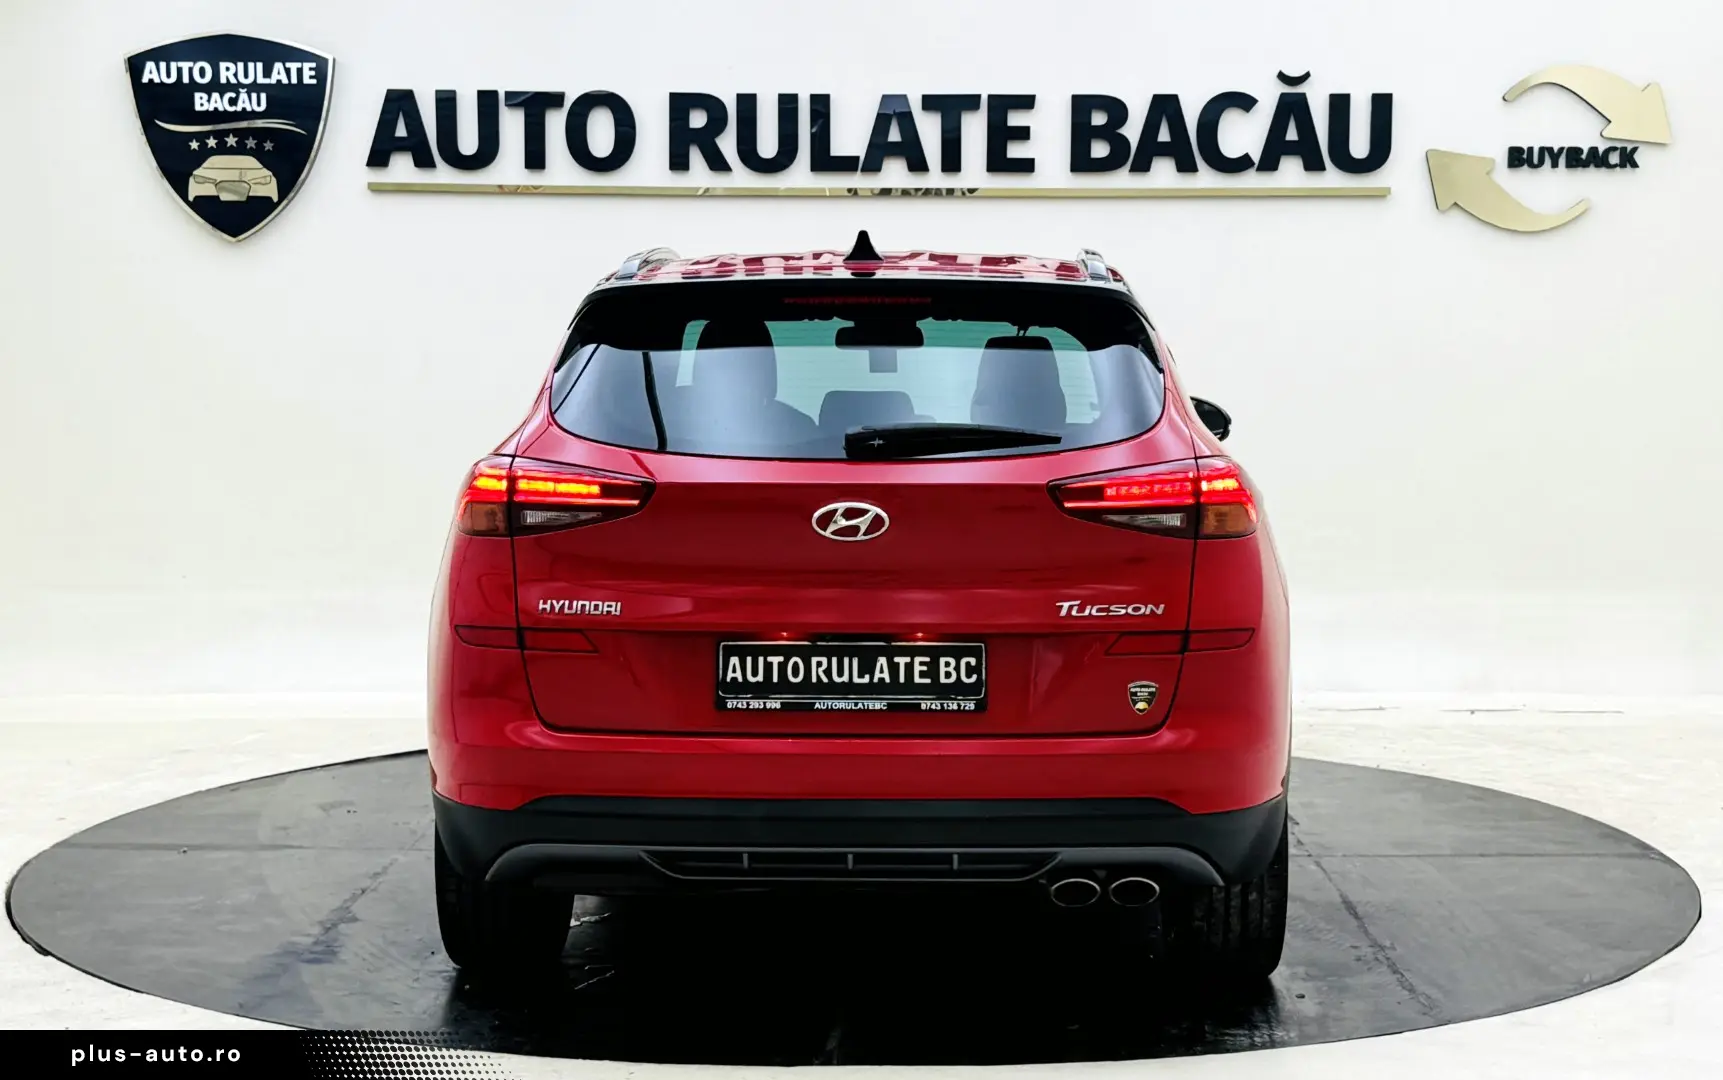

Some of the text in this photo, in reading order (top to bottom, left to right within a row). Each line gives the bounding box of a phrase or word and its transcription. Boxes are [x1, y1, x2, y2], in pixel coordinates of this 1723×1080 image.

[141, 61, 317, 85] AUTO RULATE
[193, 88, 267, 112] BACĂU
[366, 69, 1393, 174] AUTO RULATE BACĂU
[1507, 146, 1640, 169] BUYBACK
[538, 599, 622, 616] HYUNDAI
[1055, 600, 1165, 617] TUCSON
[939, 657, 978, 684] BC
[814, 702, 888, 710] AUTORULATEBC
